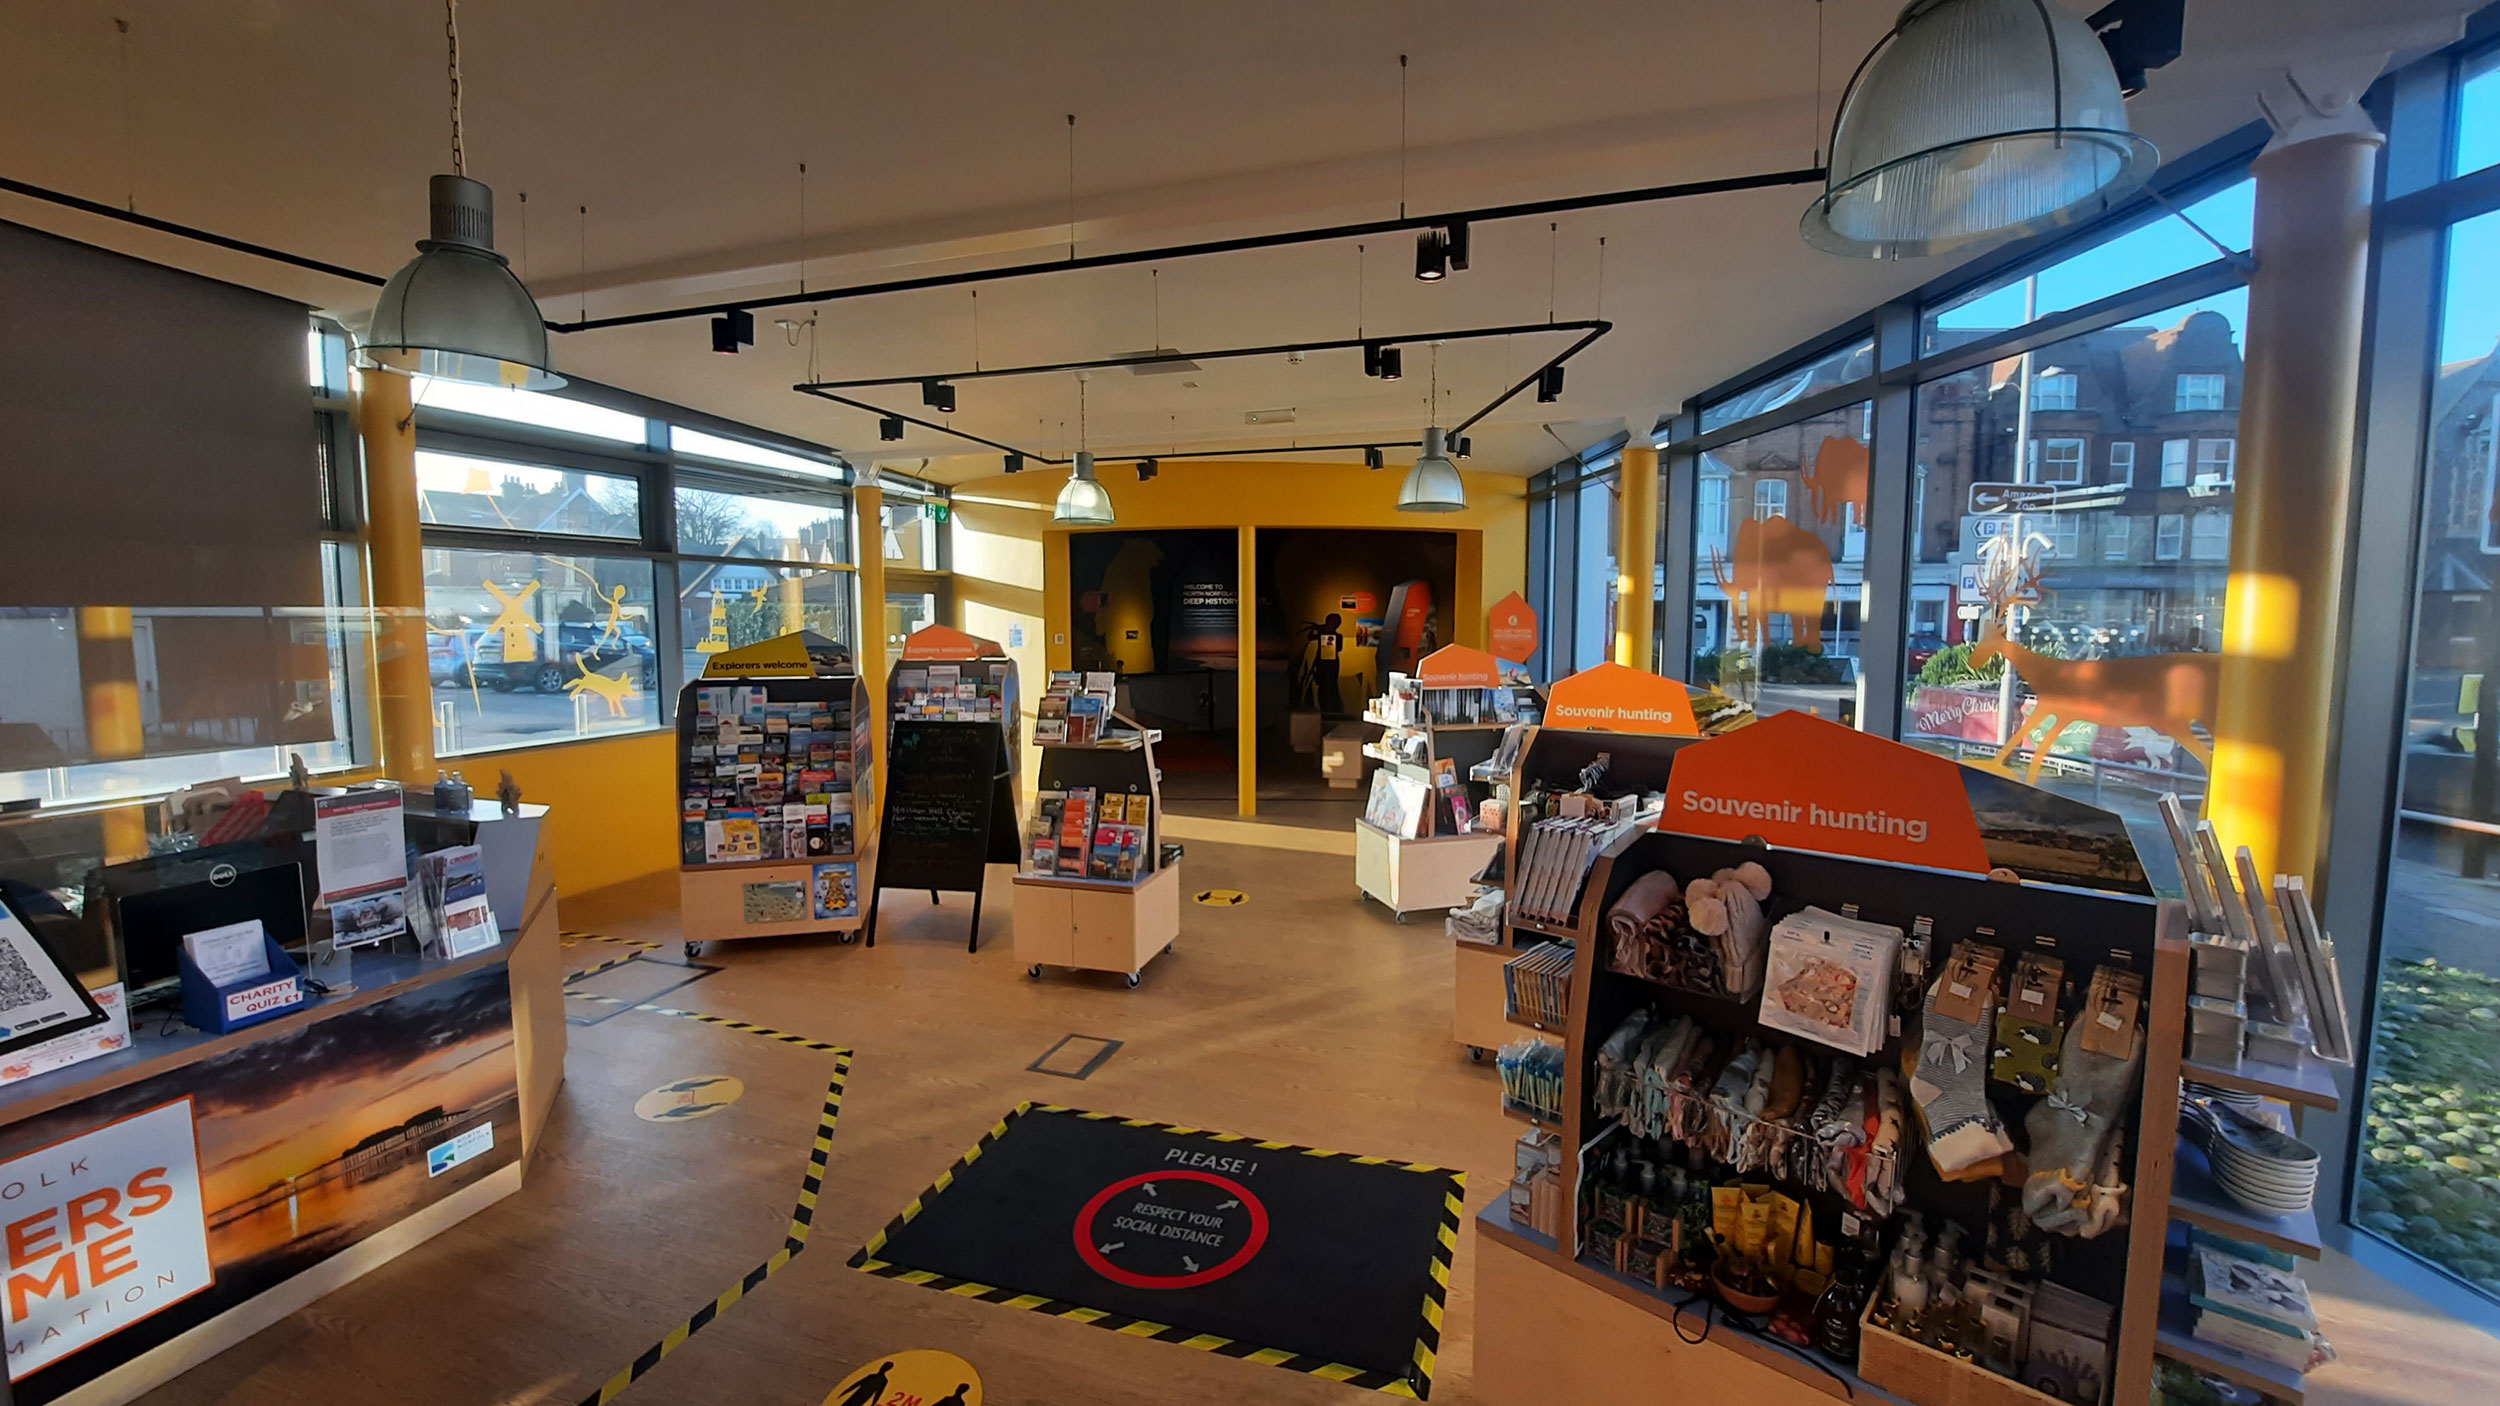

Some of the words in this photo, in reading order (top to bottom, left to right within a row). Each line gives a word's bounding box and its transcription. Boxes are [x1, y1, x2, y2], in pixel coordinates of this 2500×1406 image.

[2016, 501, 2036, 511] Zoo
[712, 661, 761, 671] Explorers
[763, 661, 808, 670] welcome
[1423, 673, 1457, 681] Souvenir
[1458, 673, 1488, 683] hunting
[1556, 704, 1615, 719] Souvenir
[1618, 707, 1673, 724] hunting
[1919, 705, 1963, 732] Merry
[1962, 696, 2001, 716] Christ
[1682, 790, 1803, 823] Souvenir
[1809, 803, 1929, 843] hunting
[213, 871, 234, 881] DELL
[230, 981, 293, 1005] CHARITY
[246, 996, 281, 1012] QUIZ
[284, 993, 300, 1004] £1
[457, 1129, 481, 1143] NORTH
[457, 1131, 490, 1149] NORFOLK
[1164, 1148, 1246, 1174] PLEASE
[2, 1156, 89, 1200] OLK
[5, 1166, 173, 1271] ERS
[1132, 1202, 1187, 1222] RESPECT
[1188, 1212, 1224, 1229] YOUR
[1113, 1216, 1158, 1236] SOCIAL
[1159, 1225, 1224, 1247] DISTANCE
[7, 1227, 138, 1324] ME
[886, 1391, 923, 1406] 2M
